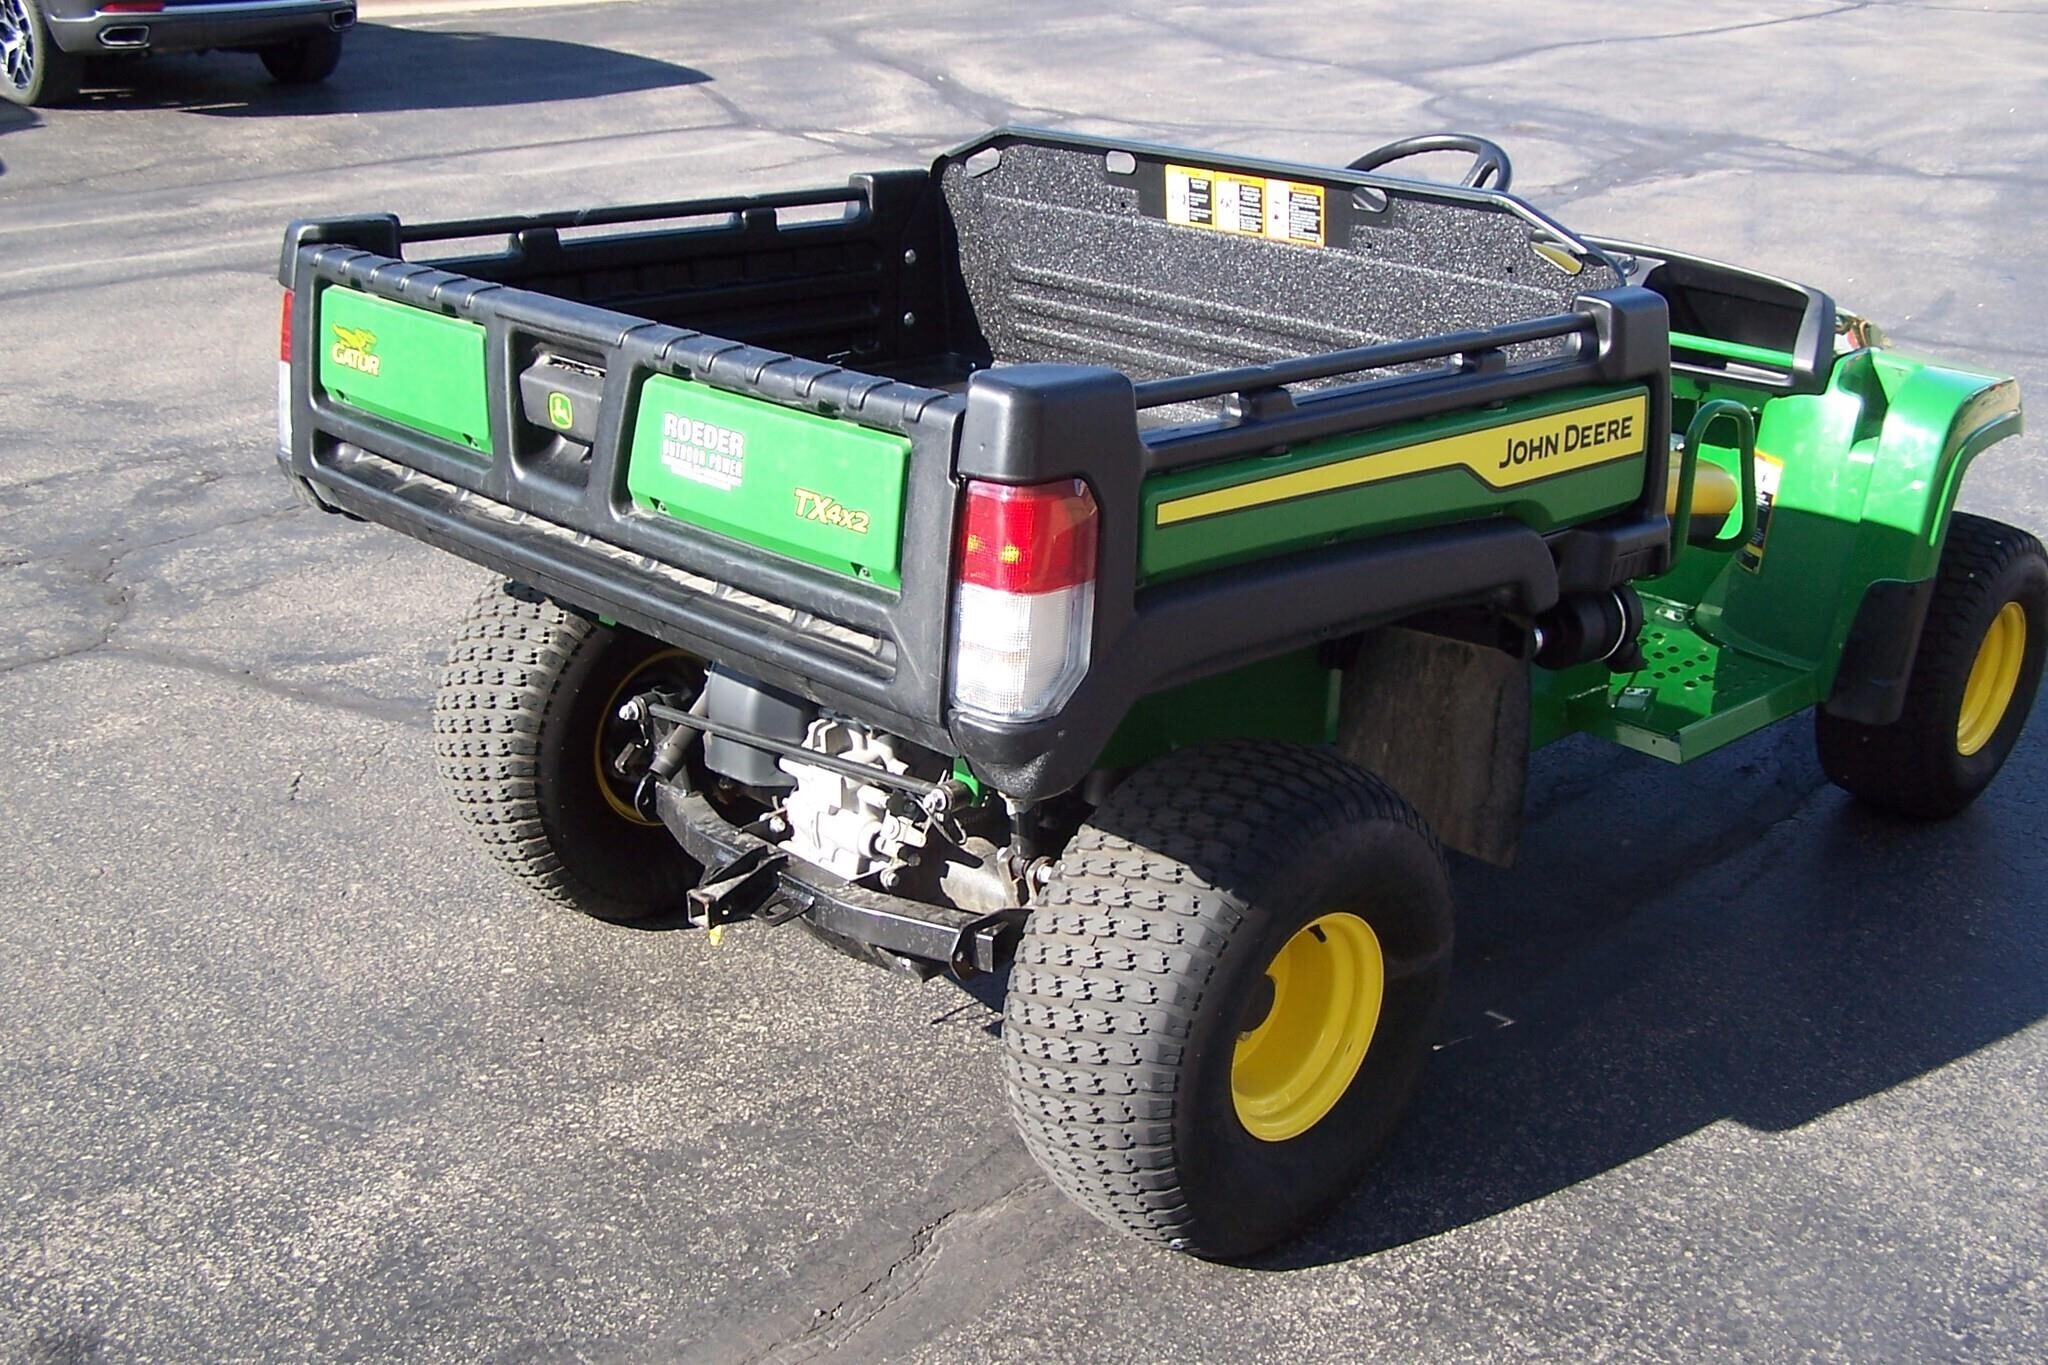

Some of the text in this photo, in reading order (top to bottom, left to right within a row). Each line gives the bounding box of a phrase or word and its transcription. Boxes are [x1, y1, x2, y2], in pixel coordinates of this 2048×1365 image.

[332, 341, 380, 378] GATOR
[664, 412, 745, 460] ROEDER
[1499, 415, 1633, 469] JOHN DEERE
